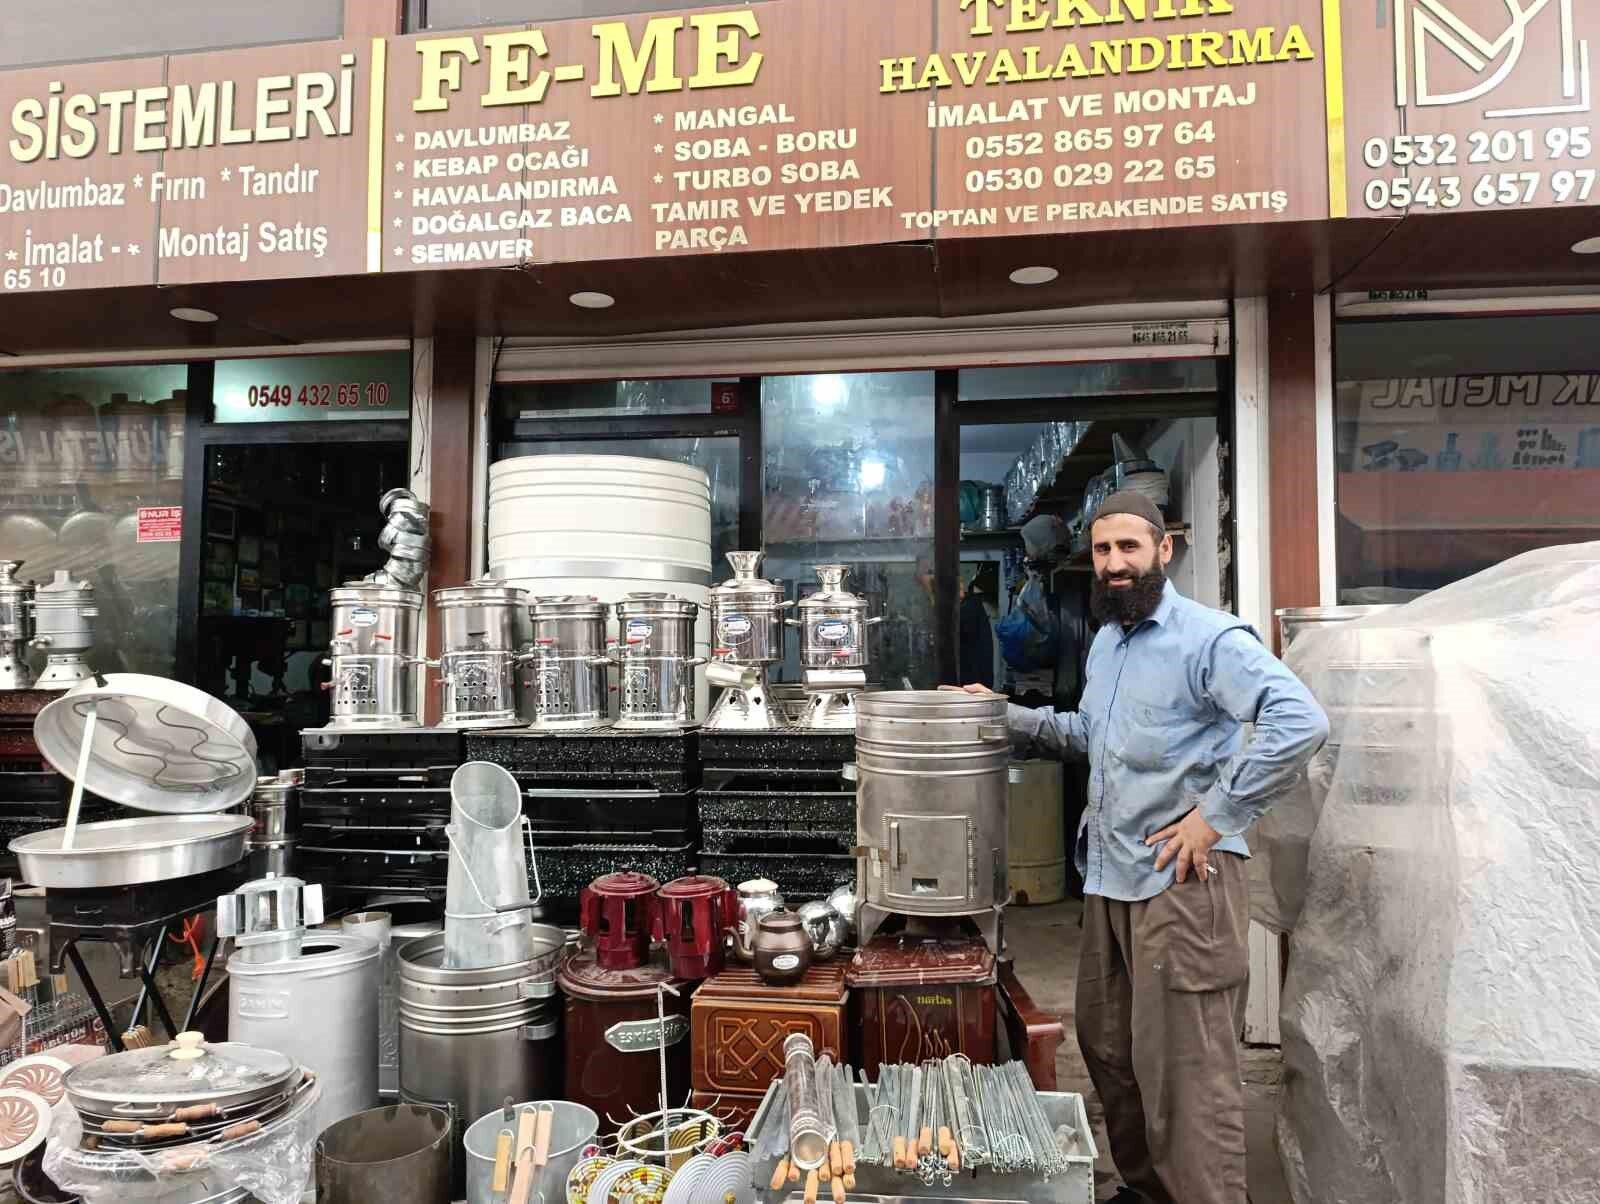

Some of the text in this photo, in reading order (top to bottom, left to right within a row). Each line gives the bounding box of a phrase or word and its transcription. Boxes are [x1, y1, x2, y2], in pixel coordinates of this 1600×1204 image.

[413, 10, 765, 112] FE-ME
[879, 24, 1315, 93] HAVALANDIRMA
[9, 54, 356, 162] SİSTEMLERİ
[674, 103, 795, 131] MANGAL
[927, 82, 1257, 128] İMALAT VE MONTAJ
[414, 121, 571, 150] DAVLUMBAZ
[674, 128, 857, 161] SOBA BORU
[966, 120, 1216, 159] 0552 865 97 64
[1364, 126, 1592, 168] 0532 201 95
[413, 145, 590, 178] KEBAP OCAĞI
[673, 160, 860, 192] TURBO SOBA
[966, 155, 1216, 193] 0530 029 22 65
[150, 172, 206, 203] Fırın
[239, 163, 319, 198] Tandır
[412, 176, 618, 206] HAVALANDIRMA
[1365, 169, 1596, 210] 0543 657 97
[748, 195, 786, 217] VE
[794, 187, 894, 213] YEDEK
[901, 190, 1288, 230] TOPTAN VE PERAKENDE SATIŞ
[411, 203, 632, 236] DOĞALGAZ BACA
[24, 221, 328, 266] İmalat Montaj Satış
[411, 239, 534, 264] SEMAVER
[655, 225, 749, 252] PARÇA
[3, 266, 66, 289] 65 10
[248, 382, 389, 408] 0549 432 65 10
